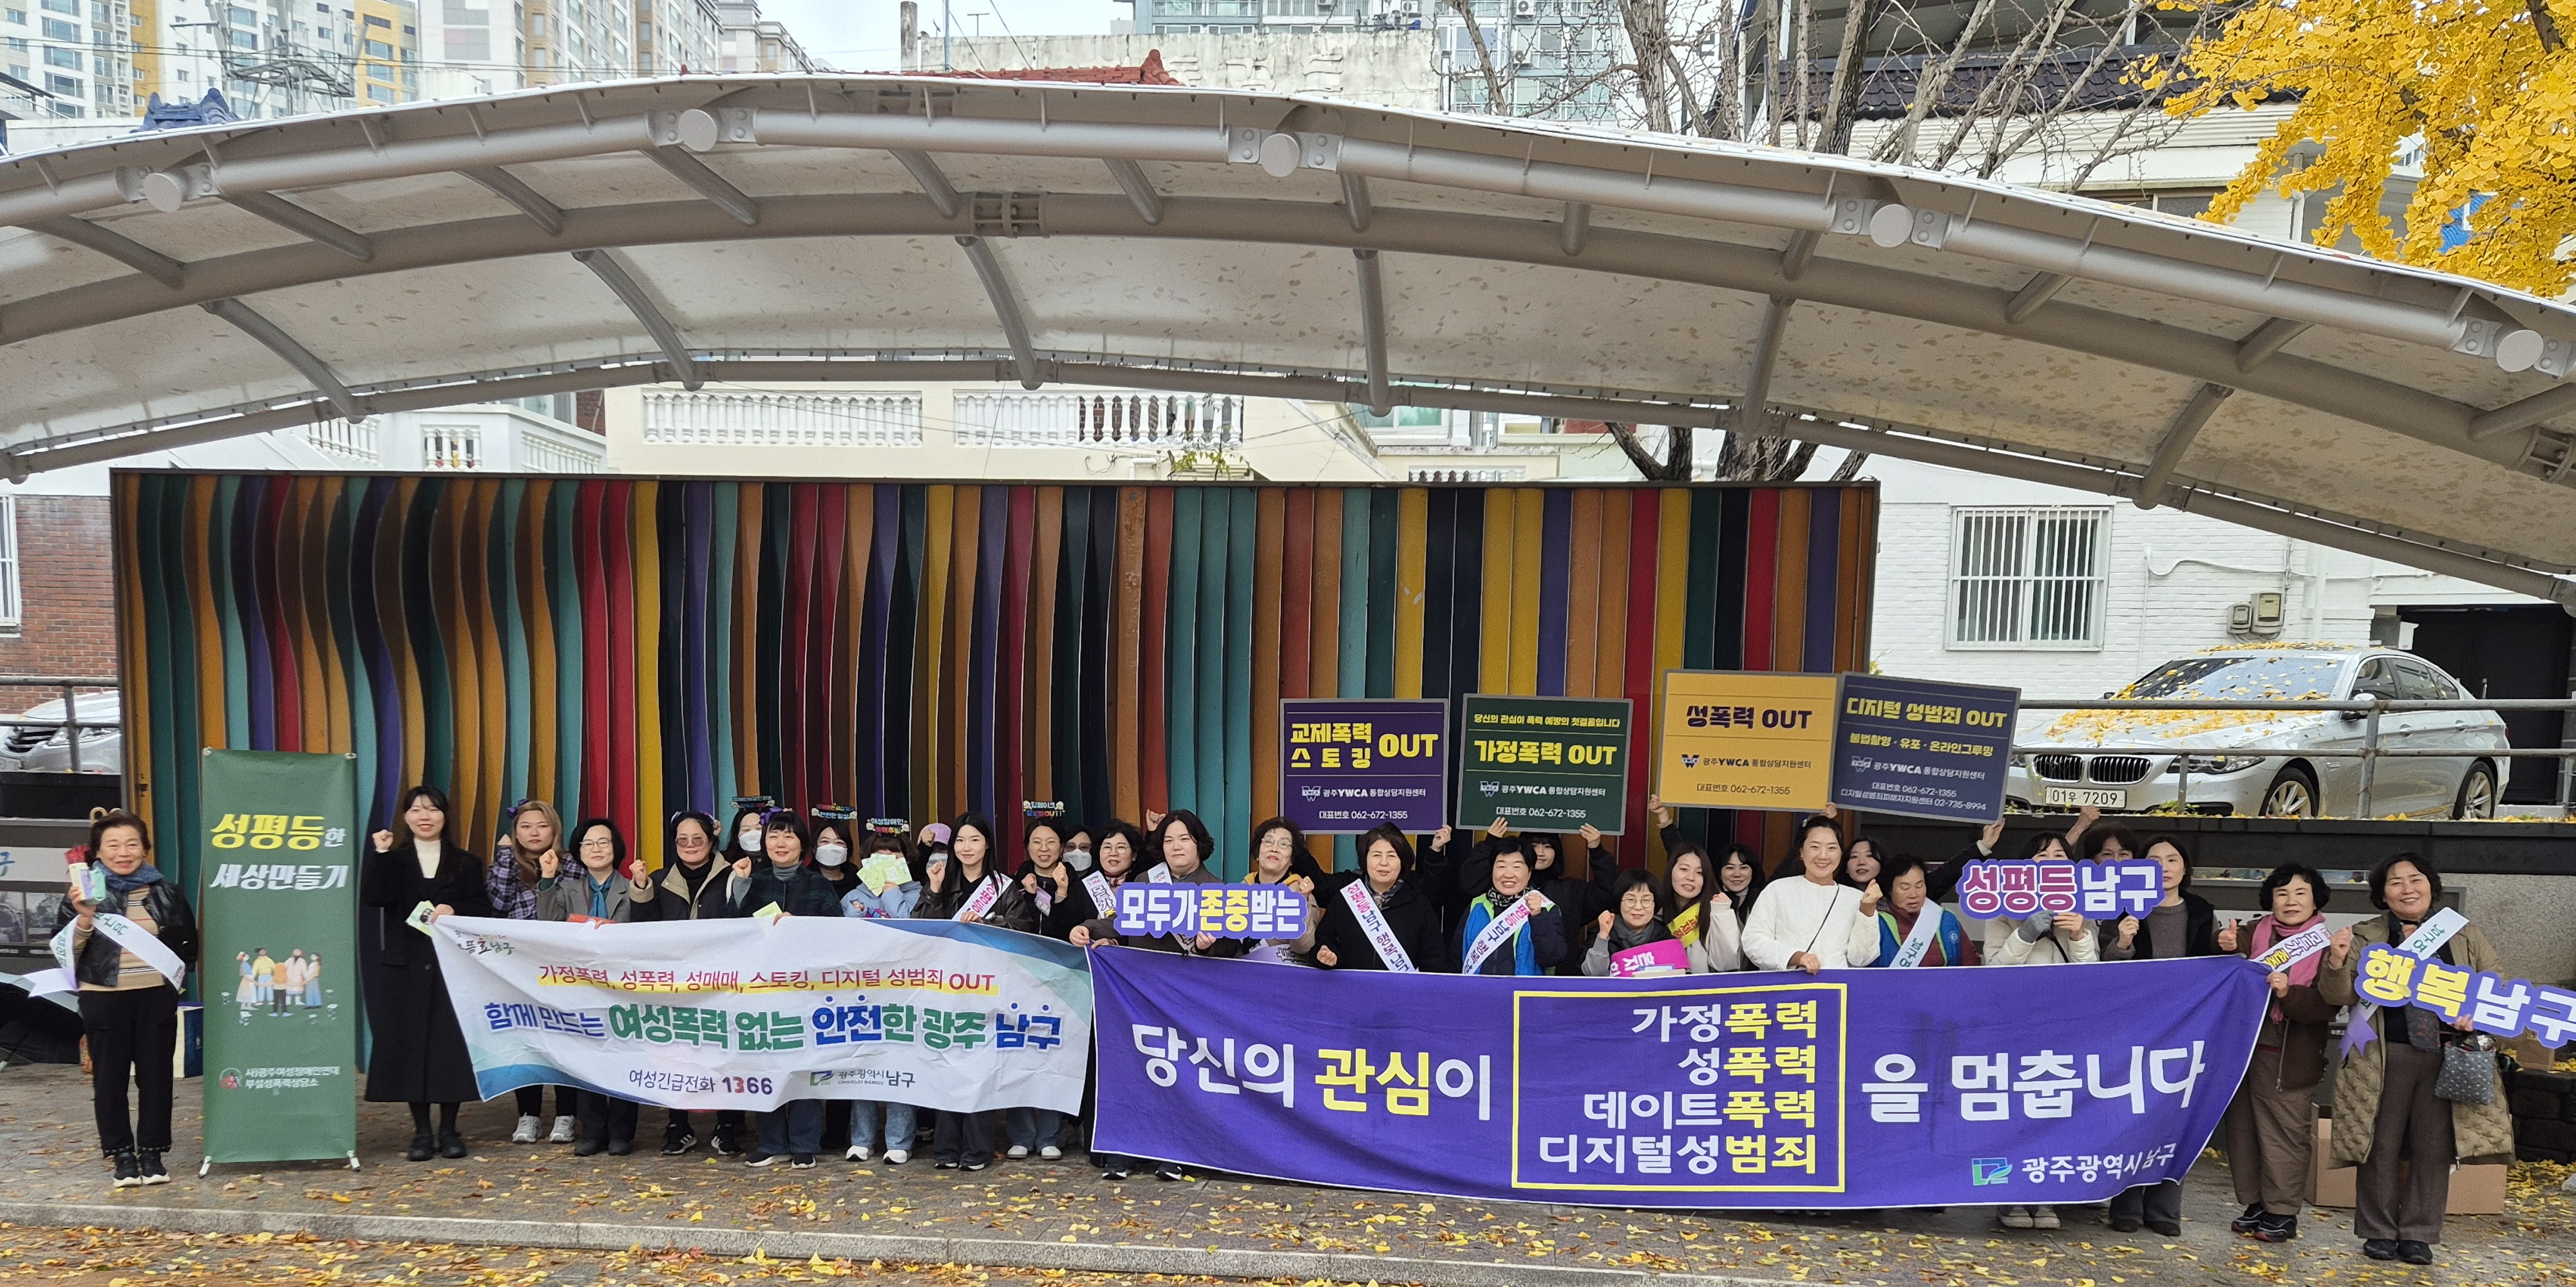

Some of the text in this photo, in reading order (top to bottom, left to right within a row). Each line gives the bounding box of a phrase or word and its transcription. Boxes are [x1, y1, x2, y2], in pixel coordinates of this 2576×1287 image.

[1474, 714, 1620, 728] 당신의 관심이 폭력 예방의 첫걸음입니다
[1685, 705, 1812, 729] 성폭력 OUT
[1846, 697, 2007, 728] 디지털 성범죄 OUT
[1291, 723, 1372, 744] 교제폭력
[1379, 733, 1438, 758] OUT
[1850, 733, 1994, 756] 불법촬영 유포 온라인그루밍
[1474, 740, 1617, 766] 가정폭력 OUT
[1703, 758, 1749, 767] 광주YWCA
[1873, 762, 1922, 774] 광주YWCA
[1323, 789, 1368, 797] 광주YWCA
[1501, 785, 1546, 794] 광주YWCA
[1697, 784, 1790, 794] 대표번호 062-672-1355
[1871, 782, 1957, 797] 대표번호 062-672-1355
[2052, 790, 2117, 805] 01우 7209
[1319, 811, 1408, 819] 대표번호 062-672-1355
[1496, 807, 1586, 818] 대표번호 062-672-1355
[1935, 799, 1986, 811] 02-735-8994
[211, 813, 346, 850] 성평등한
[210, 864, 348, 890] 세상만들기
[540, 966, 996, 993] 가정폭력, 성폭력, 성매매, 스토킹, 디지털 성범죄 OUT
[484, 1000, 1062, 1051] 함께 만드는 여성폭력 없는 안전한 광주 남구
[1631, 1000, 1817, 1043] 가정폭력
[1132, 1023, 1491, 1121] 당신의 관심이
[1678, 1045, 1817, 1086] 성폭력
[629, 1069, 773, 1095] 여성긴급전화 1366
[838, 1069, 915, 1088] 광주광역시 남구
[1862, 1040, 2205, 1123] 을 멈춥니다
[1584, 1090, 1815, 1130] 데이트폭력
[1539, 1134, 1816, 1175] 디지털성범죄
[2021, 1142, 2177, 1183] 광주광역시 남구
